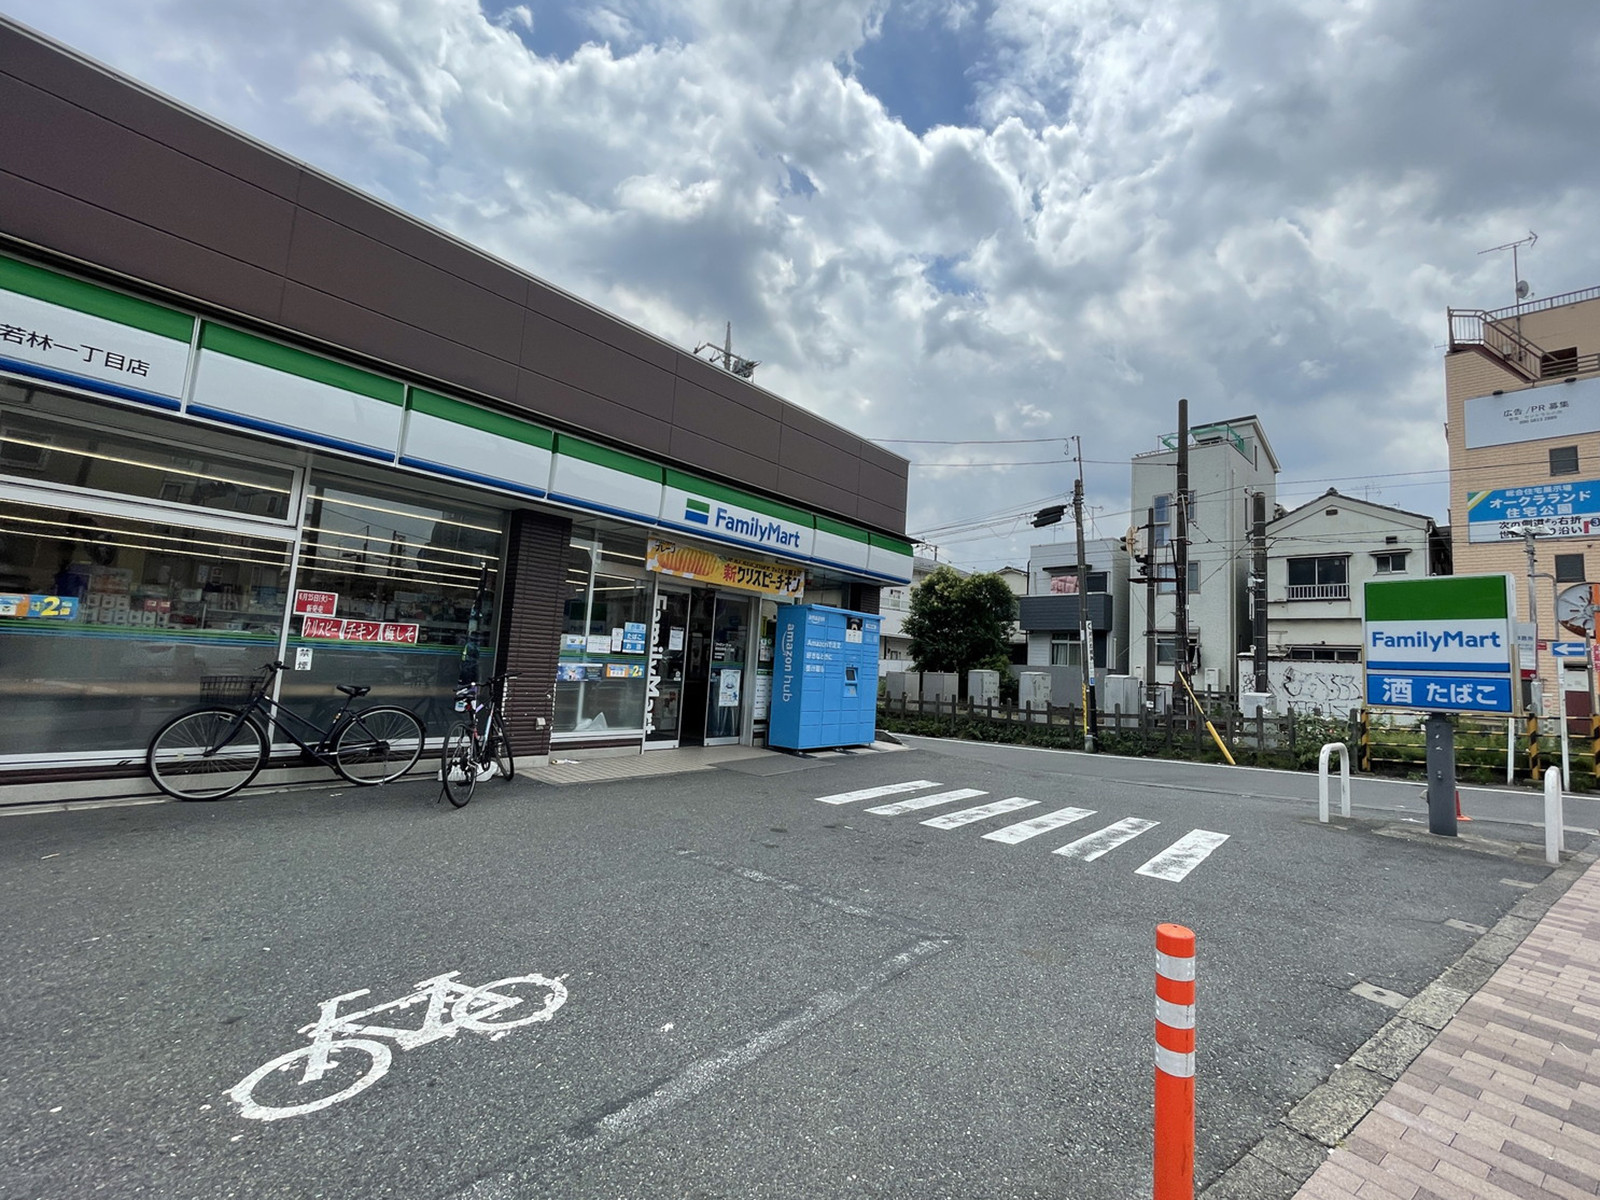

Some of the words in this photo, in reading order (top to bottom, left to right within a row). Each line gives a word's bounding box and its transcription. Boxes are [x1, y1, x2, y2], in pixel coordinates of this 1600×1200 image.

[0, 323, 151, 378] 若林一丁目店
[1490, 490, 1592, 509] オークラランド
[1506, 503, 1573, 518] 住宅公園
[715, 507, 801, 549] FamilyMart
[722, 562, 801, 593] 新クリスピーチキン
[345, 623, 379, 641] チキン
[1371, 629, 1502, 653] FamilyMart
[783, 623, 795, 672] amazon
[782, 675, 795, 703] hub
[1381, 677, 1414, 705] 酒
[1425, 682, 1498, 706] たばこ
